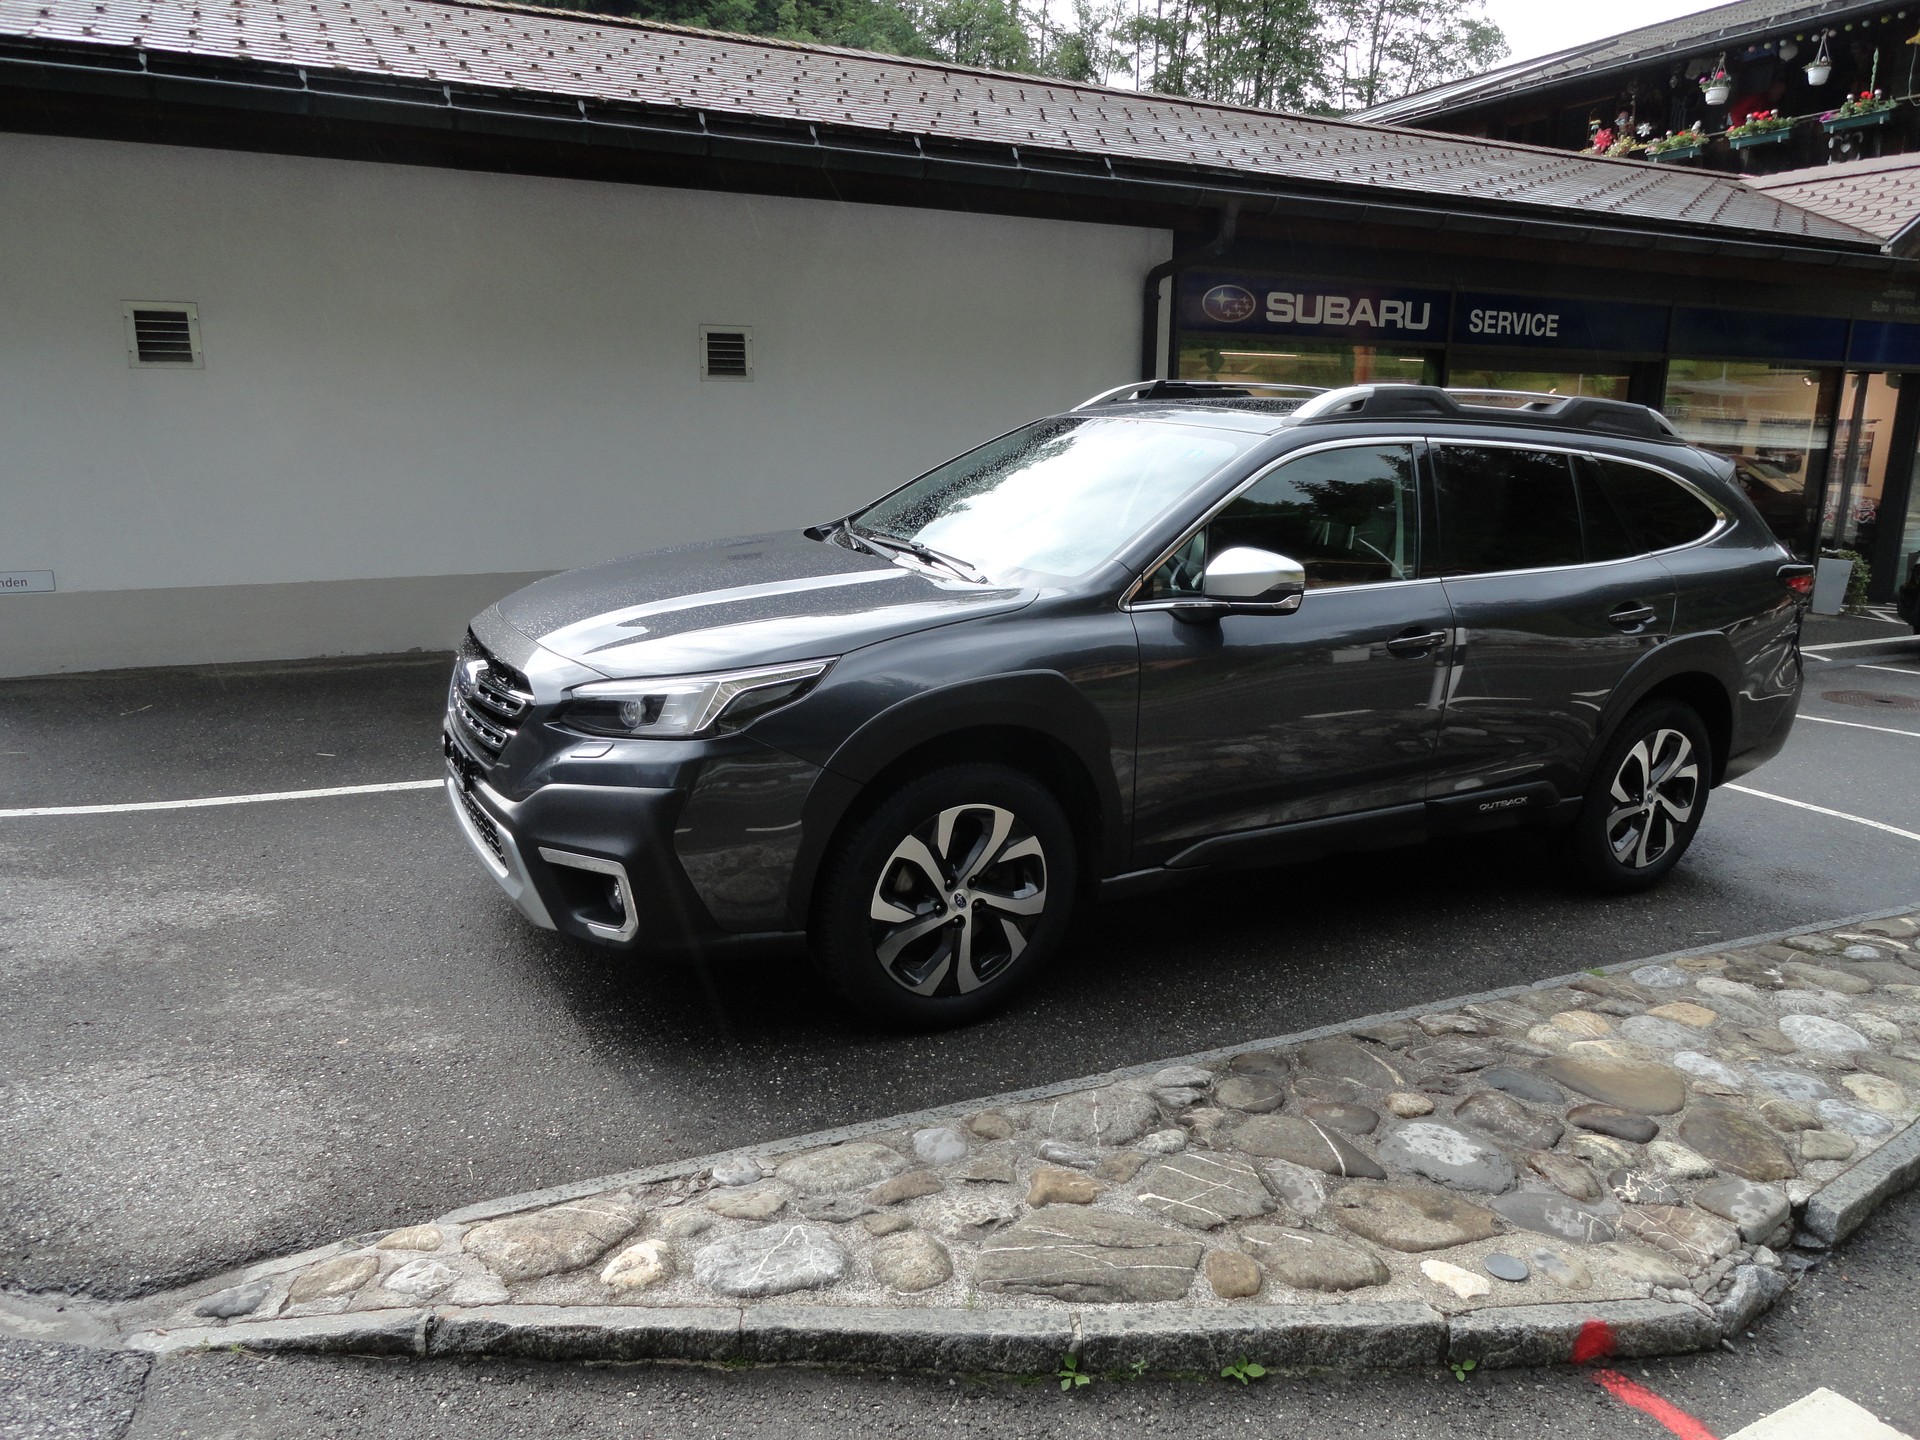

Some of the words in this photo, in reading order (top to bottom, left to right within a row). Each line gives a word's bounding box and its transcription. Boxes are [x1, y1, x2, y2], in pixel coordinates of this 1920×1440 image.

[1266, 291, 1430, 330] SUBARU
[1469, 309, 1560, 337] SERVICE
[1479, 796, 1528, 811] OUTBACK
